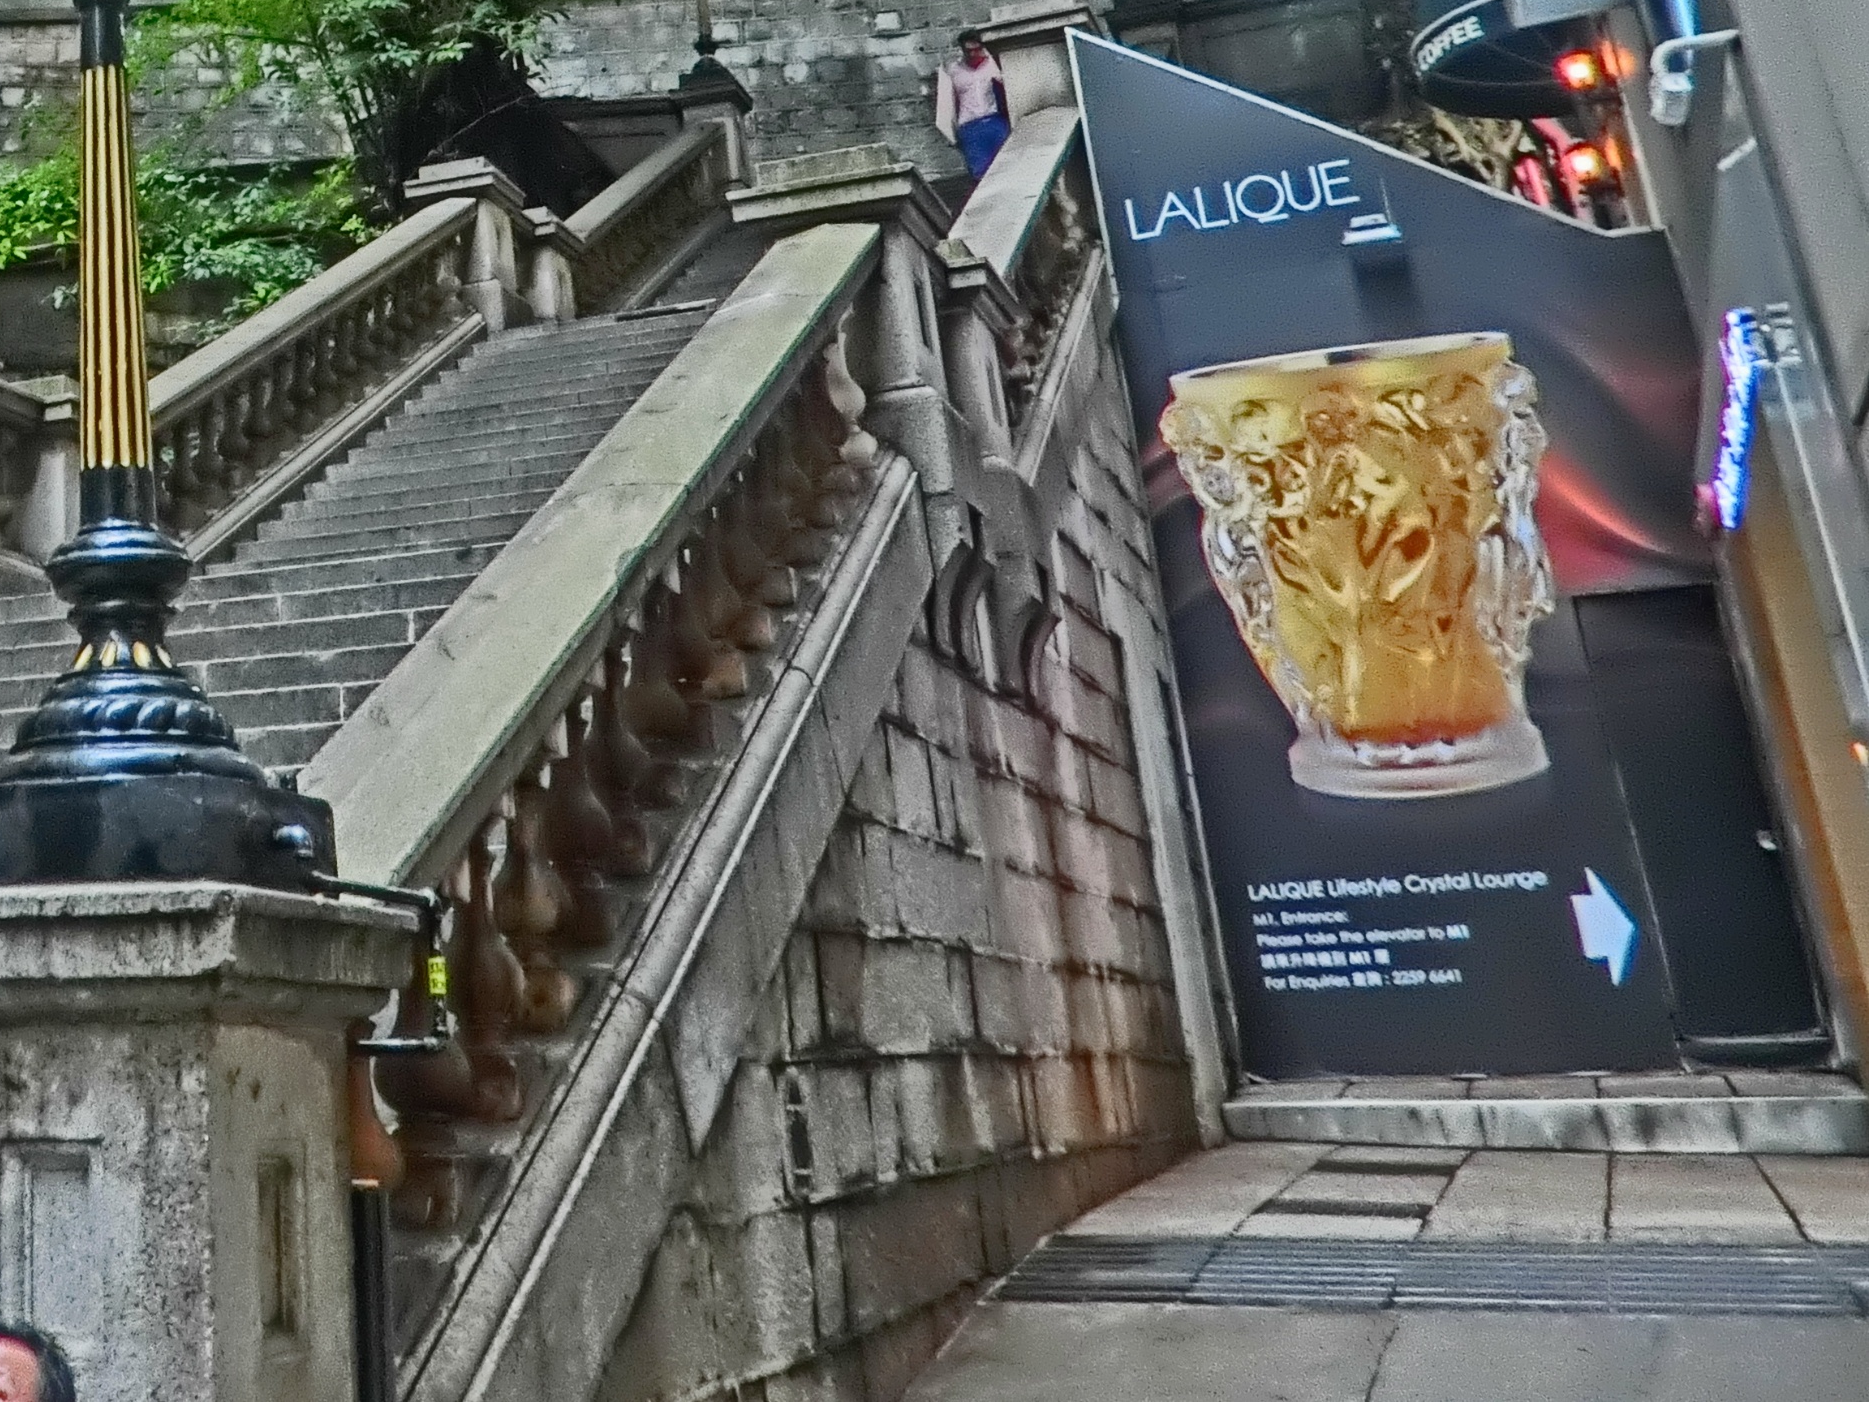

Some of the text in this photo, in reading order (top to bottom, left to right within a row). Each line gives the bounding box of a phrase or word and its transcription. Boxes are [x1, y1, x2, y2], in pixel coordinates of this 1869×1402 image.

[1416, 15, 1485, 72] COFFEE
[1123, 158, 1361, 241] LALIQUE
[1247, 871, 1548, 902] LALIQUE Lifestyle Crystal Lounge
[1256, 923, 1470, 947] Please take the elevator to M1
[1264, 975, 1286, 990] For
[1287, 973, 1350, 990] Enquiries
